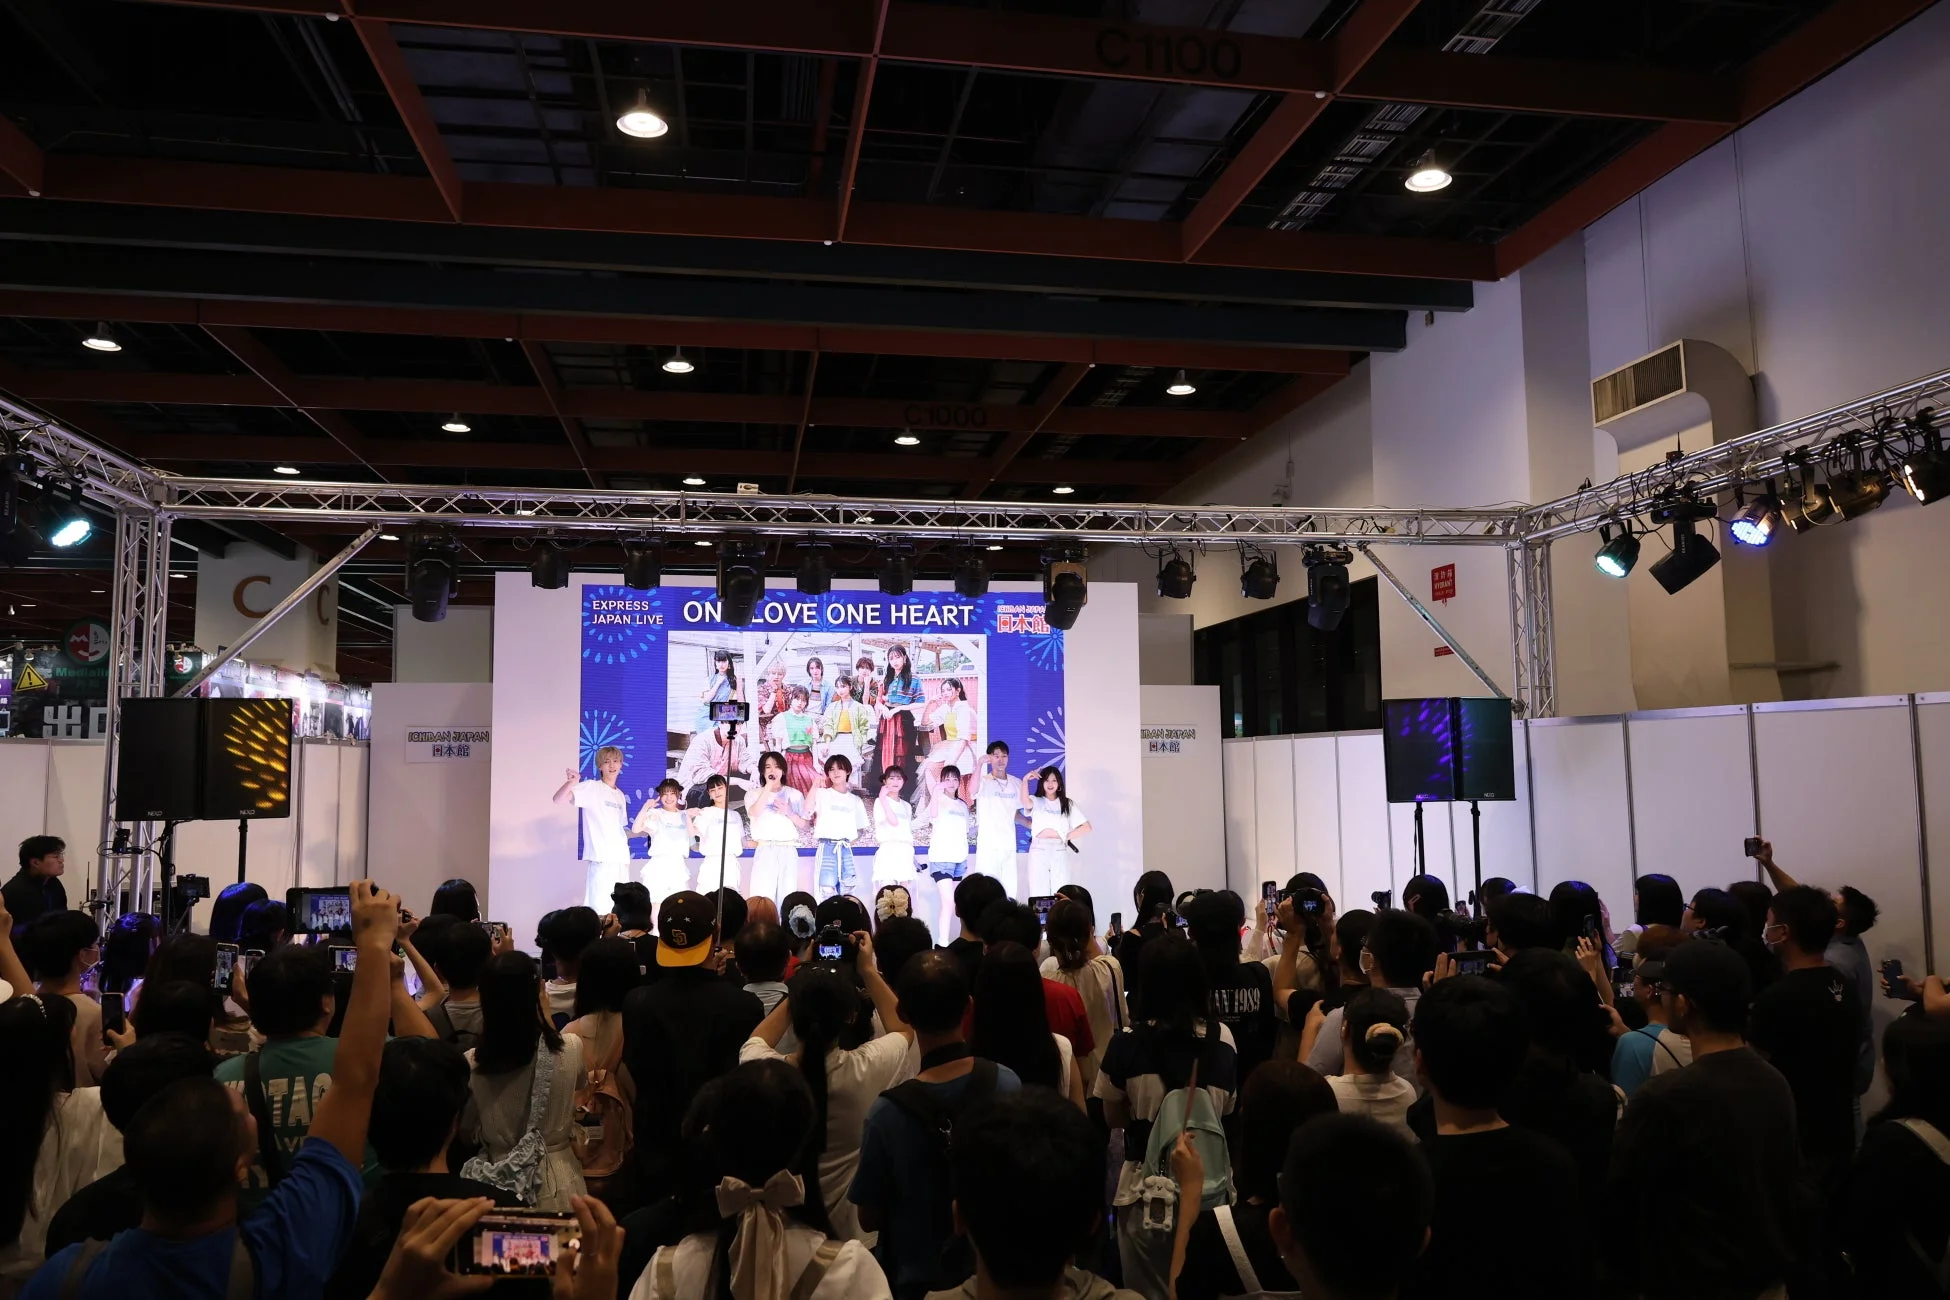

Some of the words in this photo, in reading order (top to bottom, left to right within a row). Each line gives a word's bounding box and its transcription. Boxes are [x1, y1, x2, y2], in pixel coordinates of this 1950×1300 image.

[1095, 26, 1242, 79] C1100
[903, 403, 988, 429] C1000
[233, 575, 274, 619] C
[317, 584, 330, 626] C
[592, 600, 649, 611] EXPRESS
[591, 614, 631, 625] JAPAN
[636, 615, 664, 625] LIVE
[683, 601, 722, 623] ON
[826, 603, 881, 625] ONE
[890, 604, 974, 626] HEART
[996, 614, 1051, 634] 日本館
[408, 731, 451, 743] ICHIBAN
[452, 731, 490, 743] JAPAN
[1165, 729, 1196, 740] JAPAN
[432, 744, 470, 758] 日本館
[1149, 741, 1180, 753] 日本館
[1234, 987, 1261, 1013] 1989
